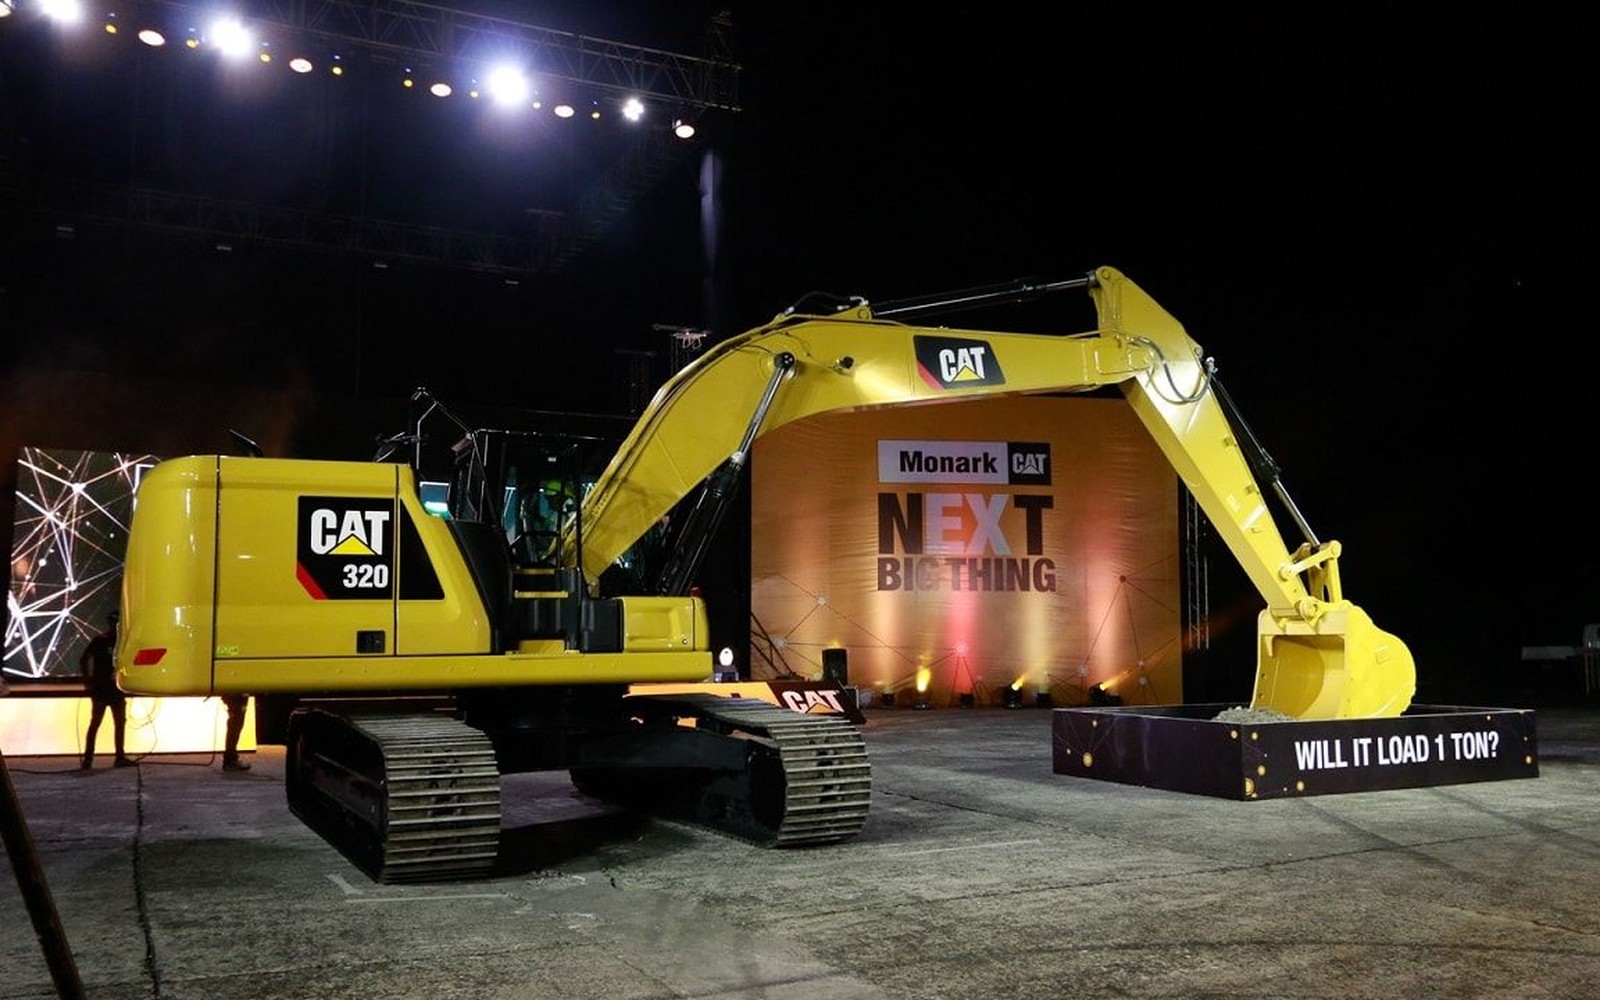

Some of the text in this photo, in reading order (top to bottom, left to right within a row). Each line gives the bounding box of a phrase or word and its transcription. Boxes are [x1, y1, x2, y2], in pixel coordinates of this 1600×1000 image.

[939, 347, 985, 382] CAT
[900, 451, 1047, 474] Monark CAT
[310, 508, 390, 555] CAT
[878, 493, 1054, 555] NEXT
[342, 563, 389, 588] 320
[877, 557, 1056, 592] BIG THING
[782, 690, 845, 714] CAT
[1295, 731, 1500, 771] WILL IT LOAD 1 TON?
